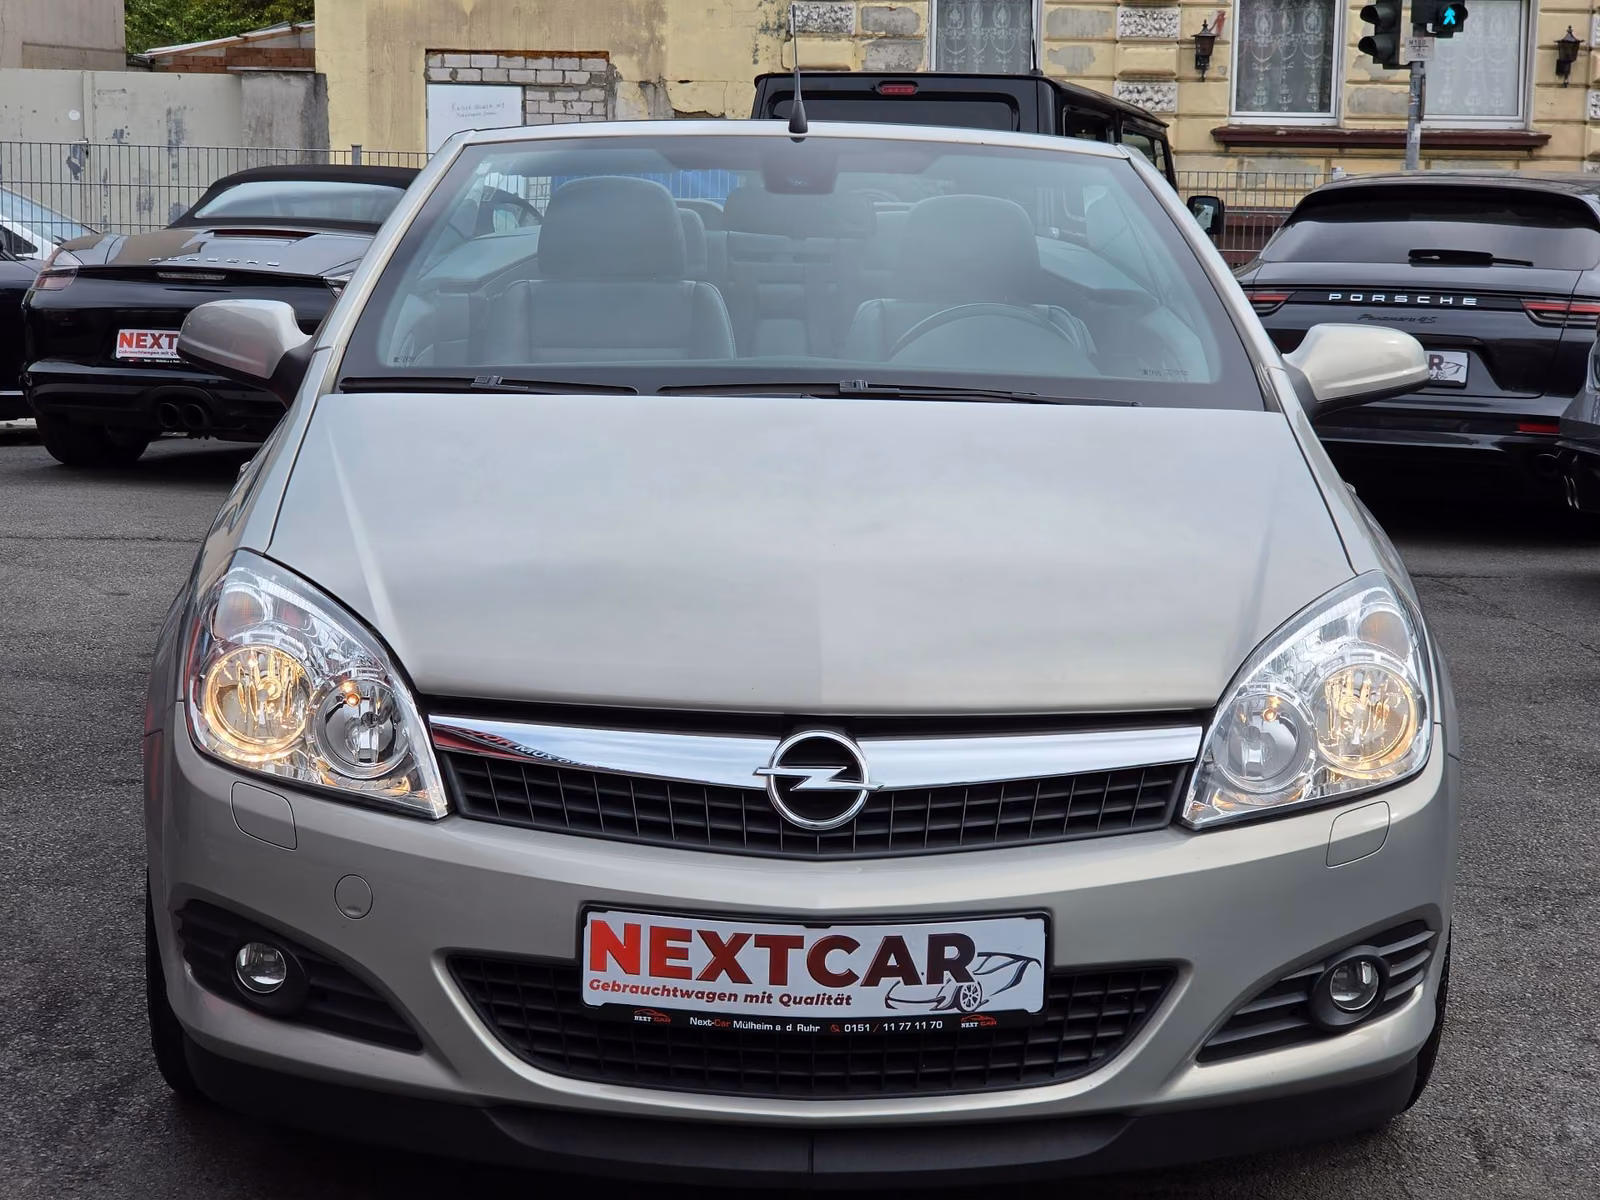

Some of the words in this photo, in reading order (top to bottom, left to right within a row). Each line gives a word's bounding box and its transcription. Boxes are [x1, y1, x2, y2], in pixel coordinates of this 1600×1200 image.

[1329, 293, 1477, 306] PORSCHE
[119, 332, 179, 349] NEXT
[589, 918, 976, 989] NEXTCAR
[588, 978, 738, 1003] Gebrauchtwagen
[743, 991, 774, 1005] mit
[778, 992, 852, 1008] Qualität
[733, 1020, 773, 1031] Mülheim
[797, 1023, 821, 1032] Ruhr
[844, 1023, 870, 1033] 0151
[883, 1023, 895, 1031] 11
[898, 1022, 912, 1031] 77
[914, 1021, 926, 1030] 11
[929, 1020, 943, 1029] 70
